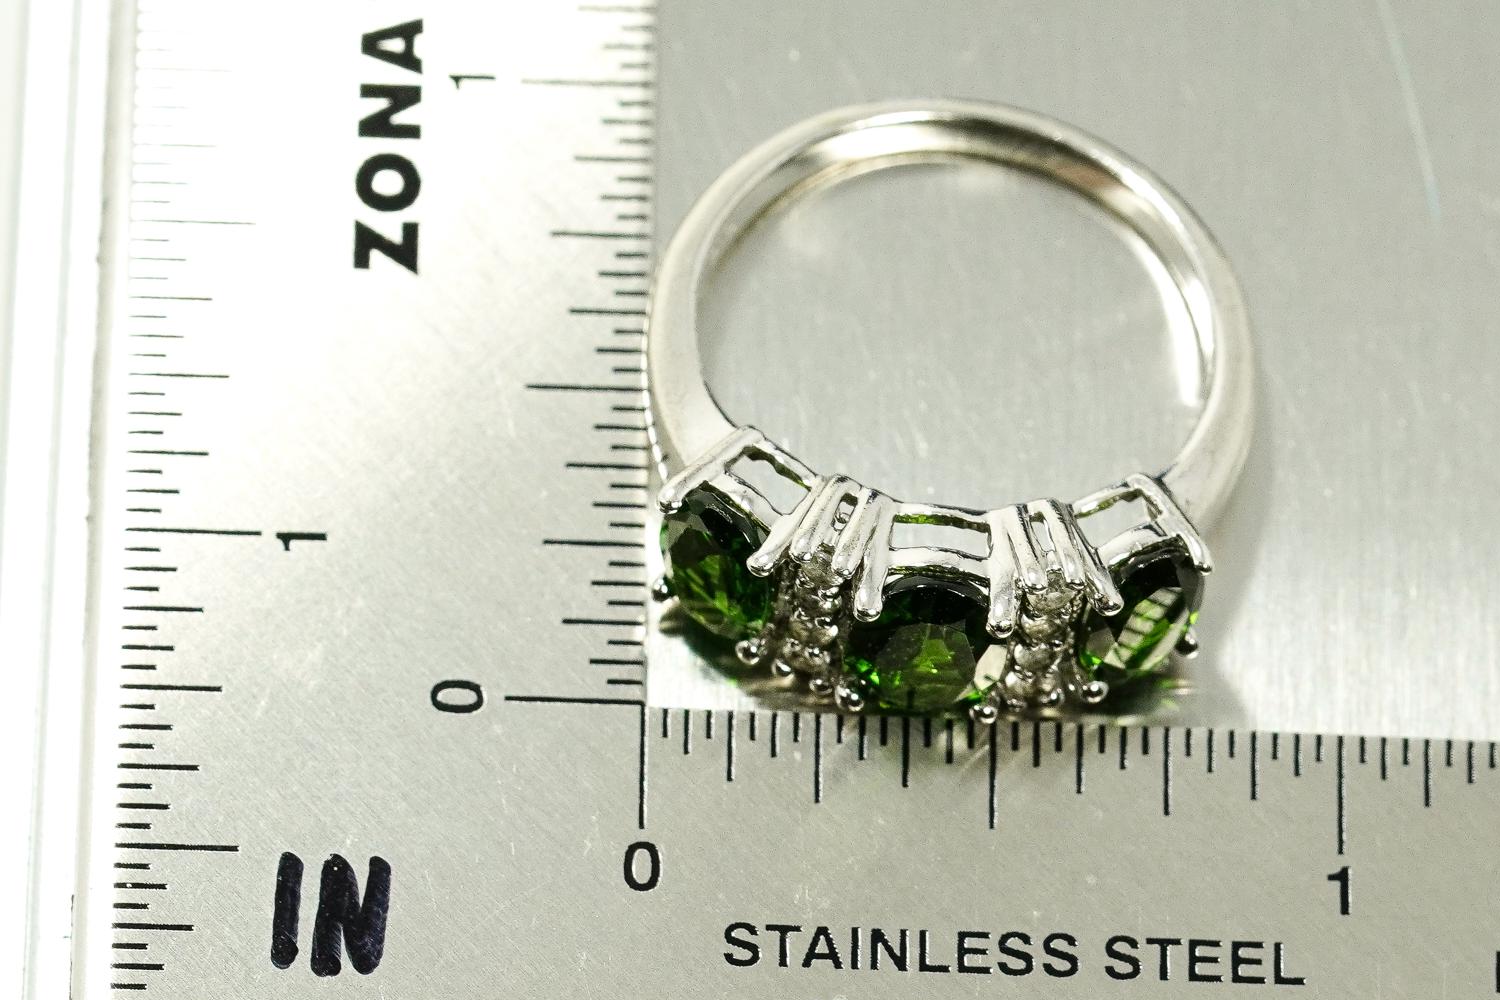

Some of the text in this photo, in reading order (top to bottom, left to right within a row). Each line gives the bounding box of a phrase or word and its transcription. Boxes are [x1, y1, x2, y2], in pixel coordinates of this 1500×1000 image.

[449, 74, 496, 90] 1
[354, 19, 424, 275] ZONA
[275, 532, 328, 552] 1
[430, 679, 486, 714] 0
[623, 841, 661, 891] 0
[1327, 866, 1352, 916] 1
[271, 852, 392, 977] IN
[723, 922, 1307, 986] STAINLESS STEEL
